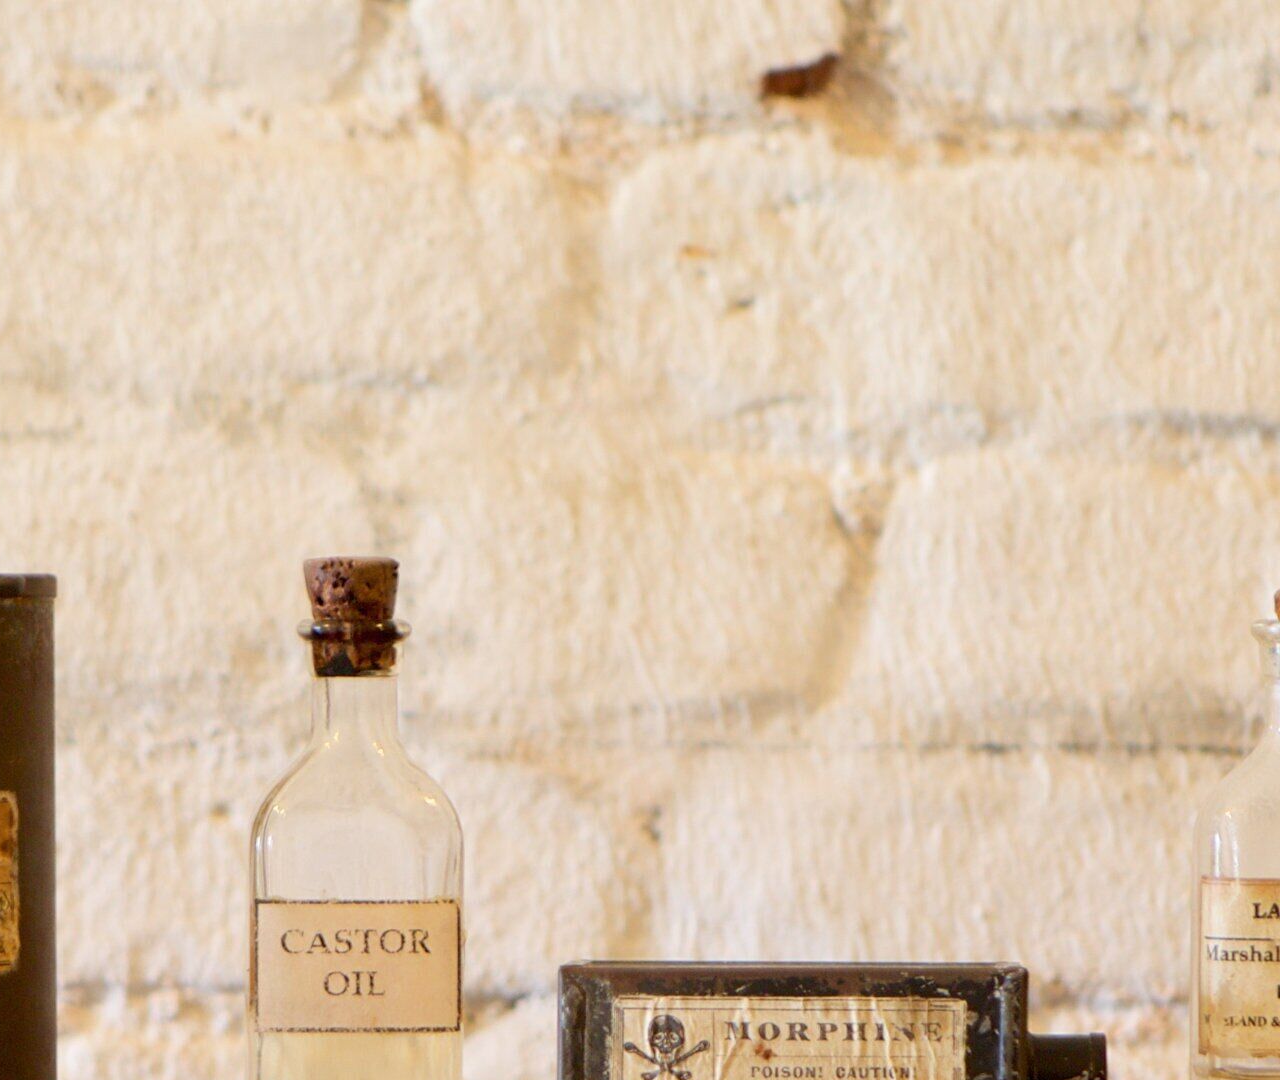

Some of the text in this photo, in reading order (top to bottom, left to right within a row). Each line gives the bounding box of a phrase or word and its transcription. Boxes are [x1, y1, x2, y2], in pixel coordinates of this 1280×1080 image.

[280, 928, 431, 954] CASTOR
[323, 970, 386, 996] OIL
[724, 1021, 943, 1042] MORPHINE
[1271, 1016, 1280, 1027] &
[751, 1066, 823, 1079] POISON!
